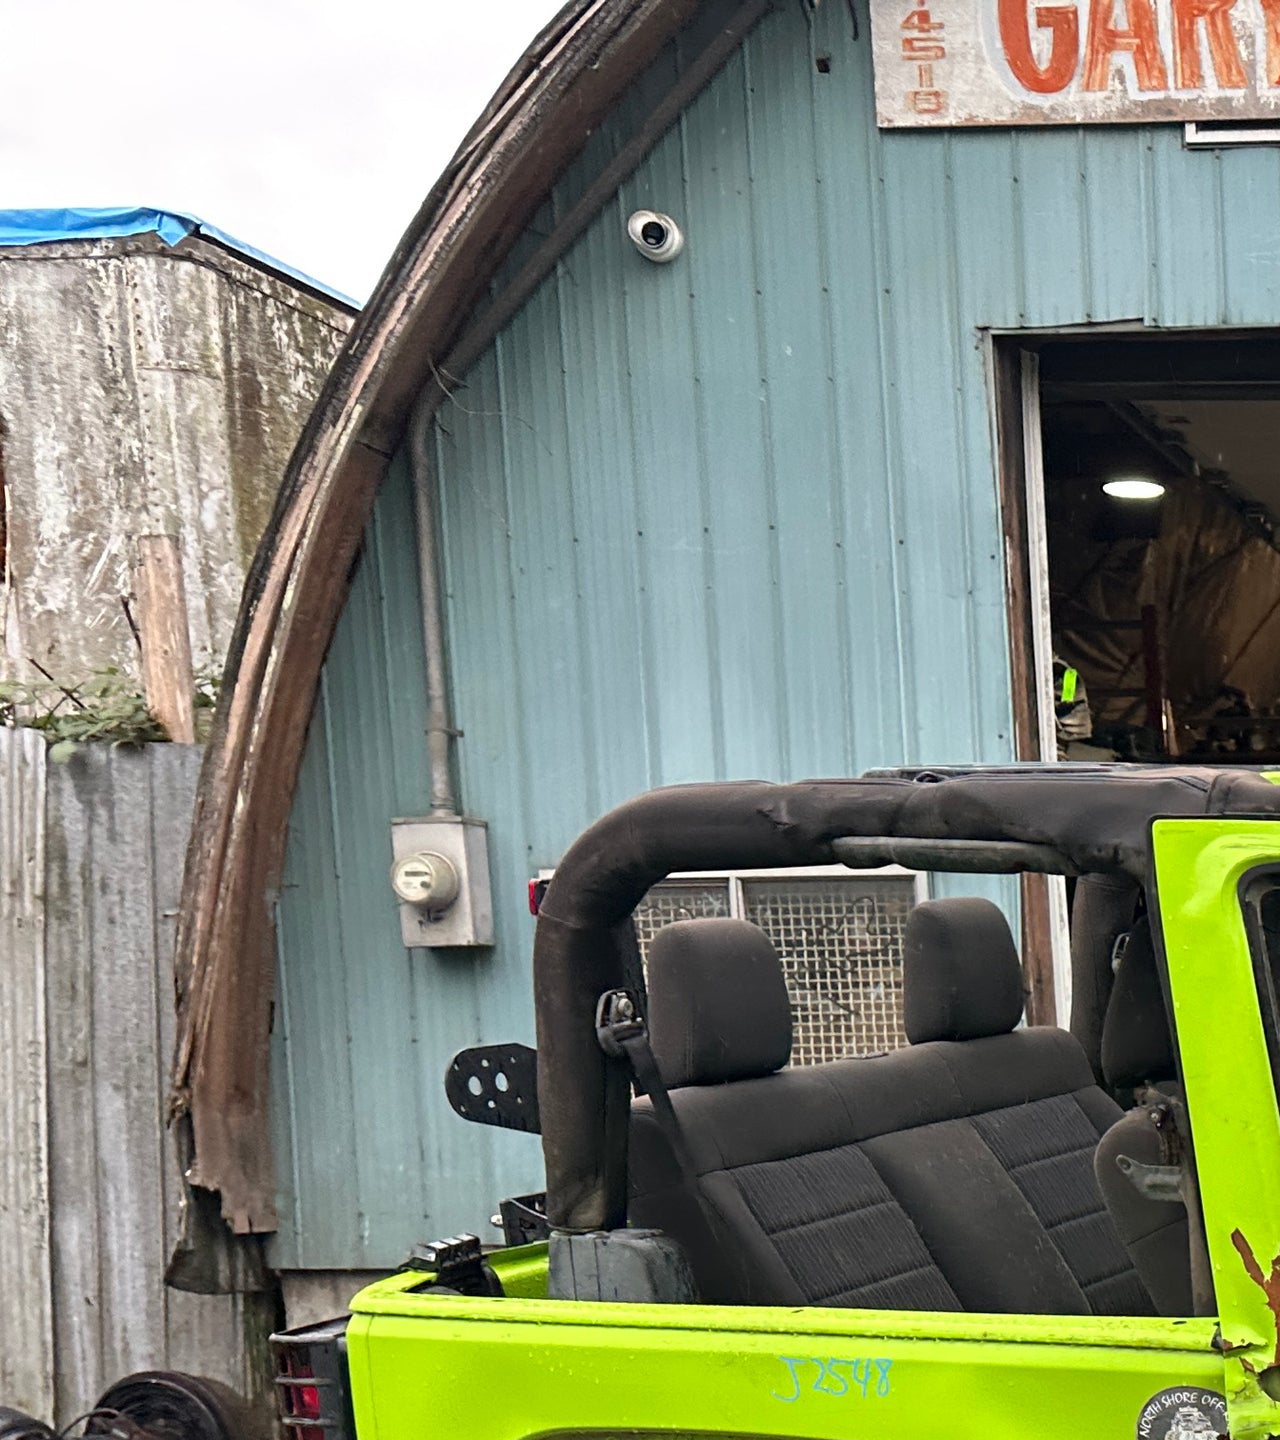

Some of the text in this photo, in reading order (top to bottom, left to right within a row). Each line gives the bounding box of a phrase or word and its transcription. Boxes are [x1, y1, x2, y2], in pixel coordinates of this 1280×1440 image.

[771, 1356, 893, 1403] J2548
[1139, 1402, 1163, 1439] NORTH
[1161, 1391, 1199, 1409] SHORE
